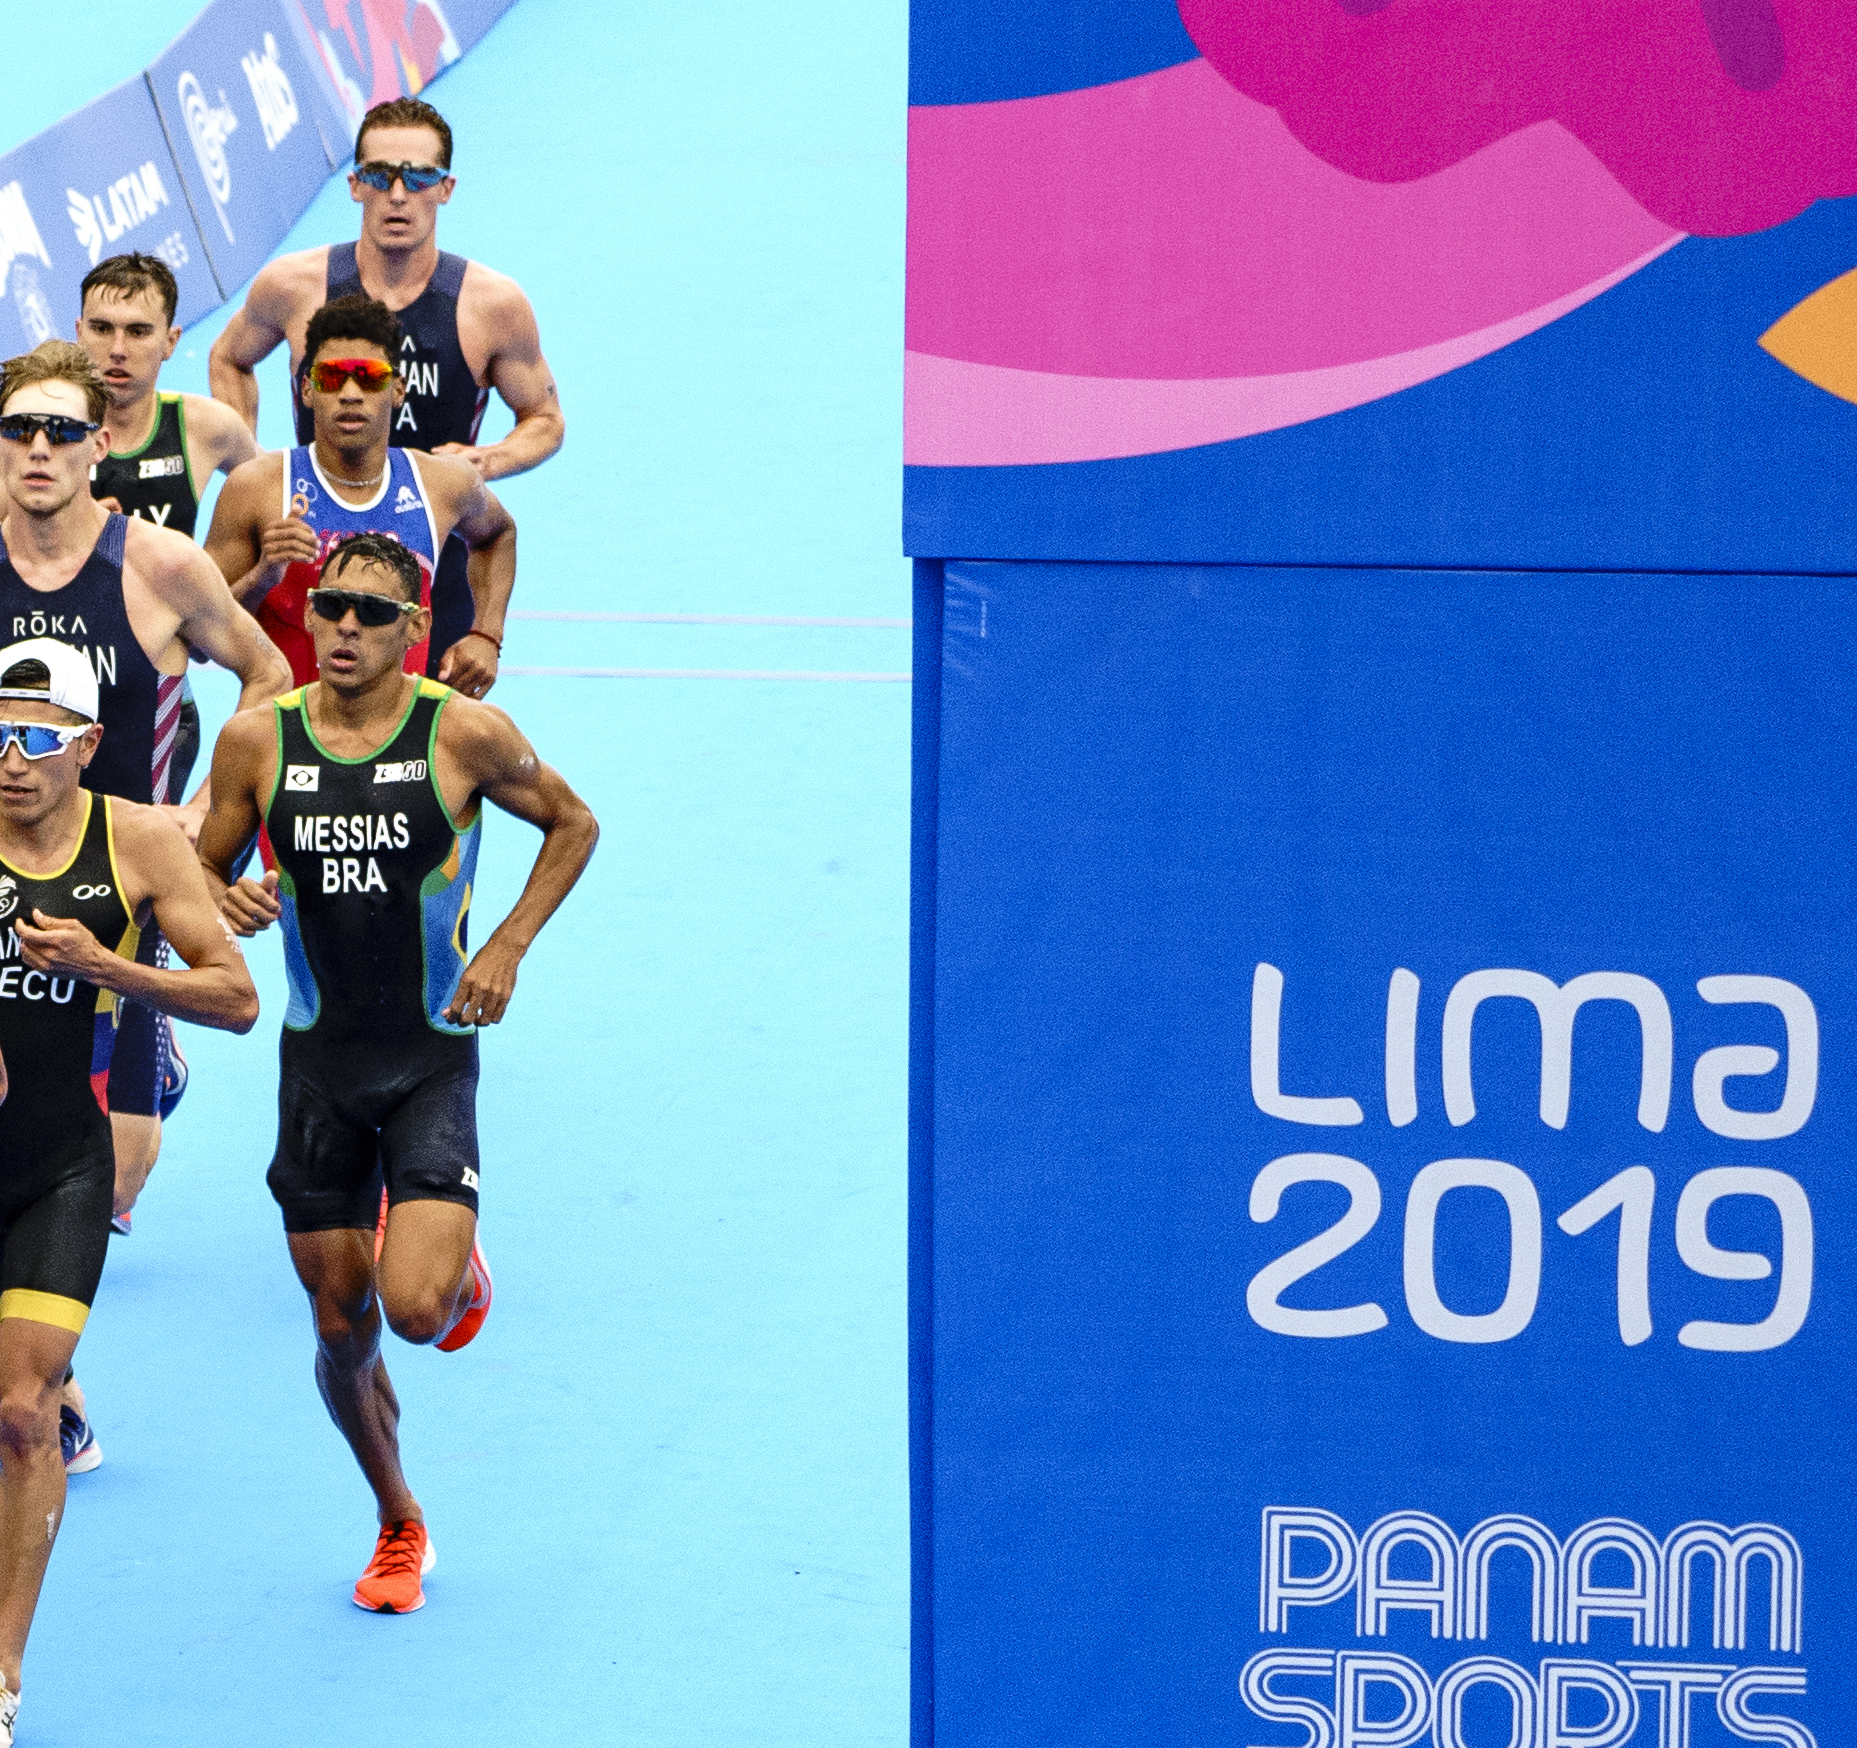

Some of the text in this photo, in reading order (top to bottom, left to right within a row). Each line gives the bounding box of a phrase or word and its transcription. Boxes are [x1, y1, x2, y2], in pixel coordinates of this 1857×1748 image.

[294, 812, 410, 852] MESSIAS
[322, 857, 388, 893] BRA
[1245, 1152, 1815, 1352] 2019
[1259, 1505, 1804, 1654] PANAM
